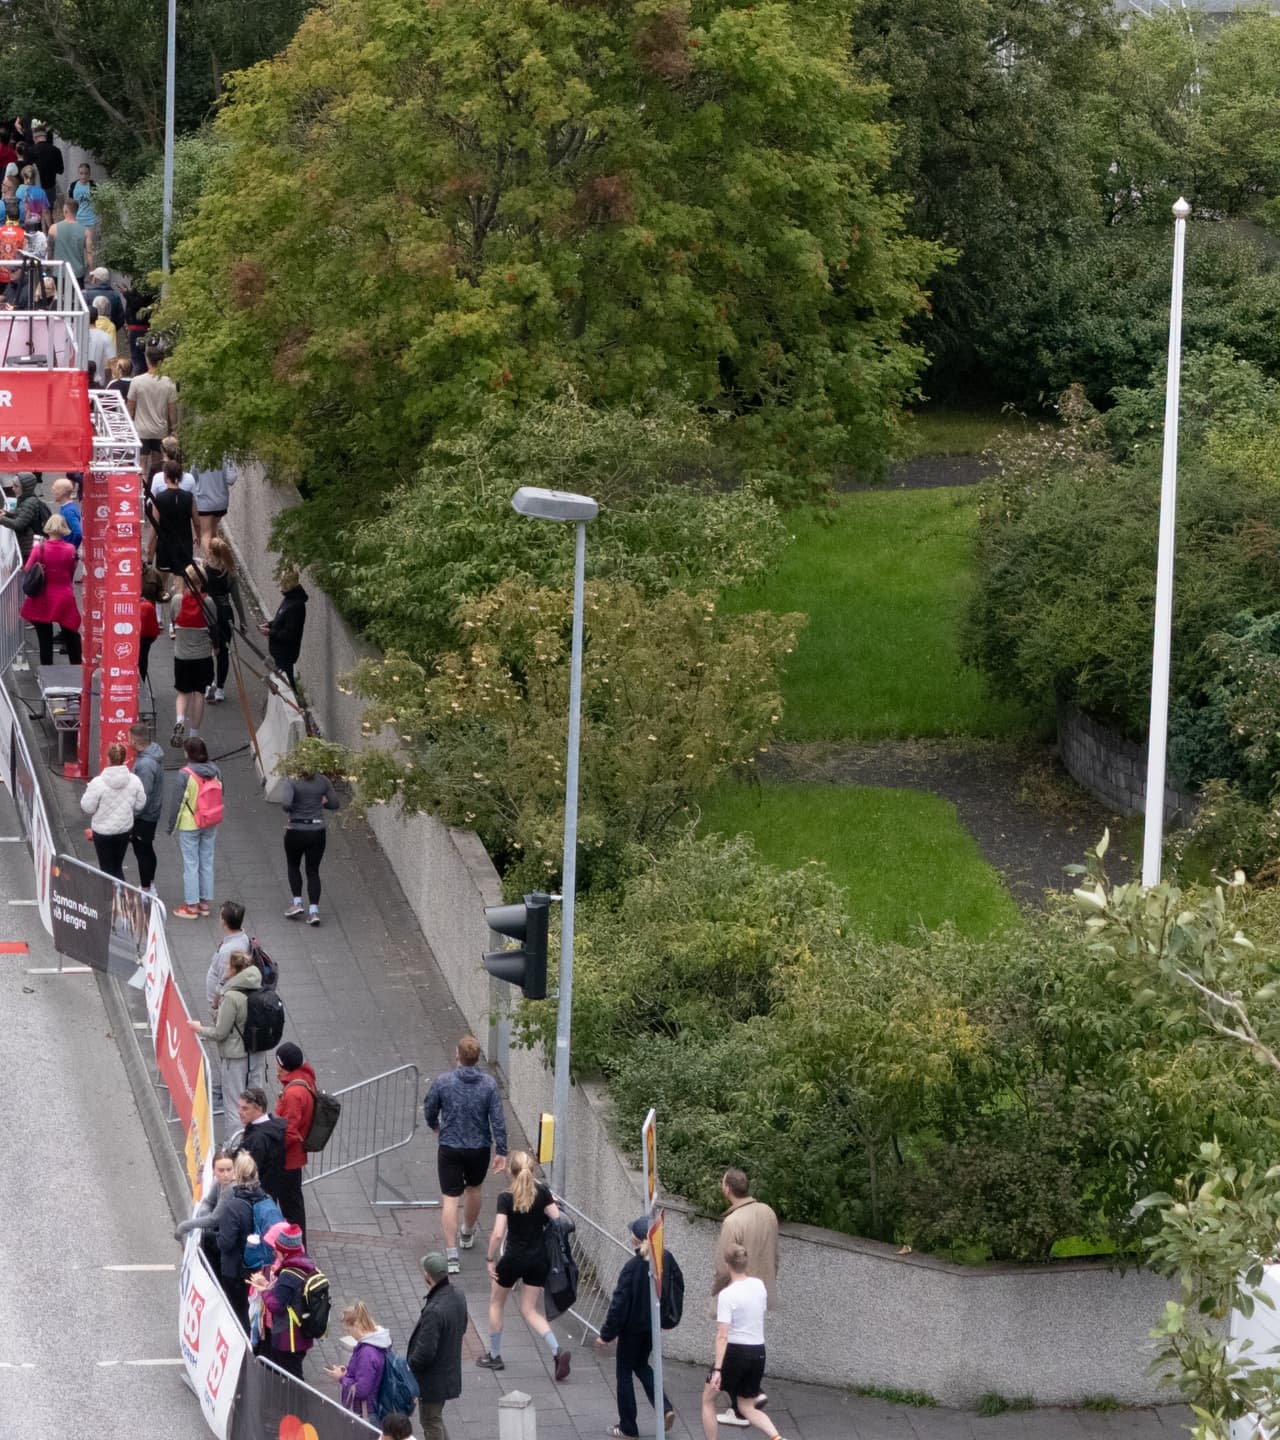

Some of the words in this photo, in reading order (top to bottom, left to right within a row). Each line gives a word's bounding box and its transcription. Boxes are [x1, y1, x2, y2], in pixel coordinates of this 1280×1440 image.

[52, 889, 78, 911] Saman
[78, 902, 99, 920] náum
[62, 911, 87, 930] lengra
